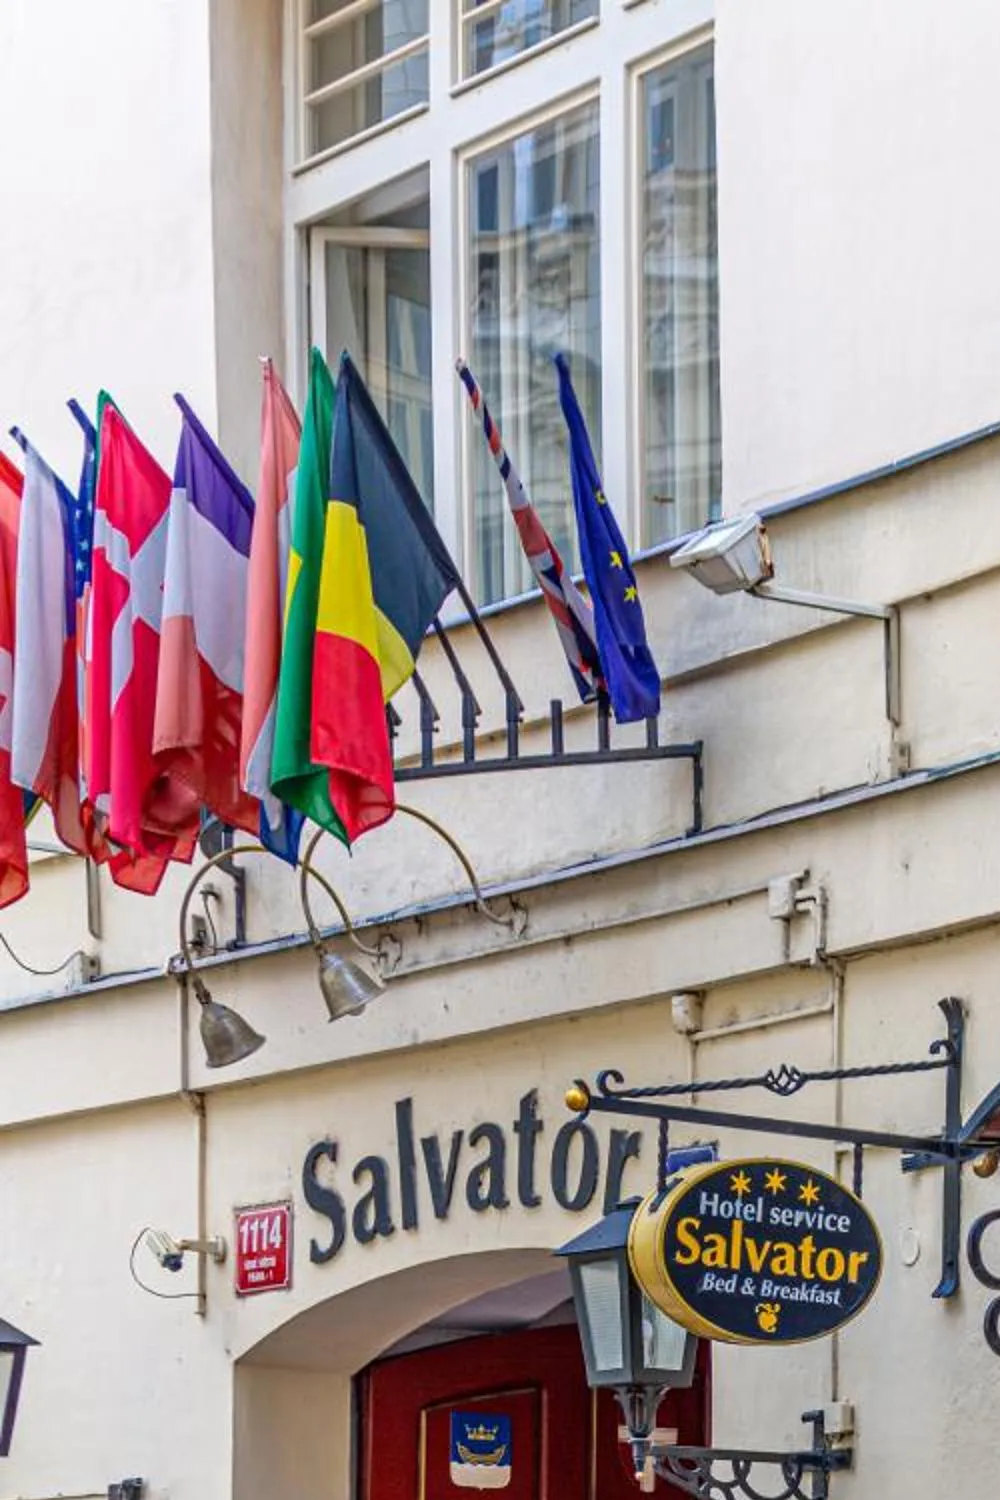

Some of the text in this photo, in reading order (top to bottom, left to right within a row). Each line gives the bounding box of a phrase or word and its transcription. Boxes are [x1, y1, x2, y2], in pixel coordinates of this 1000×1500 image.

[301, 1088, 641, 1264] Salvator
[699, 1191, 851, 1233] Hotel service
[240, 1215, 282, 1254] 1114
[675, 1217, 869, 1283] Salvator
[703, 1272, 842, 1305] Bed & Breakfast
